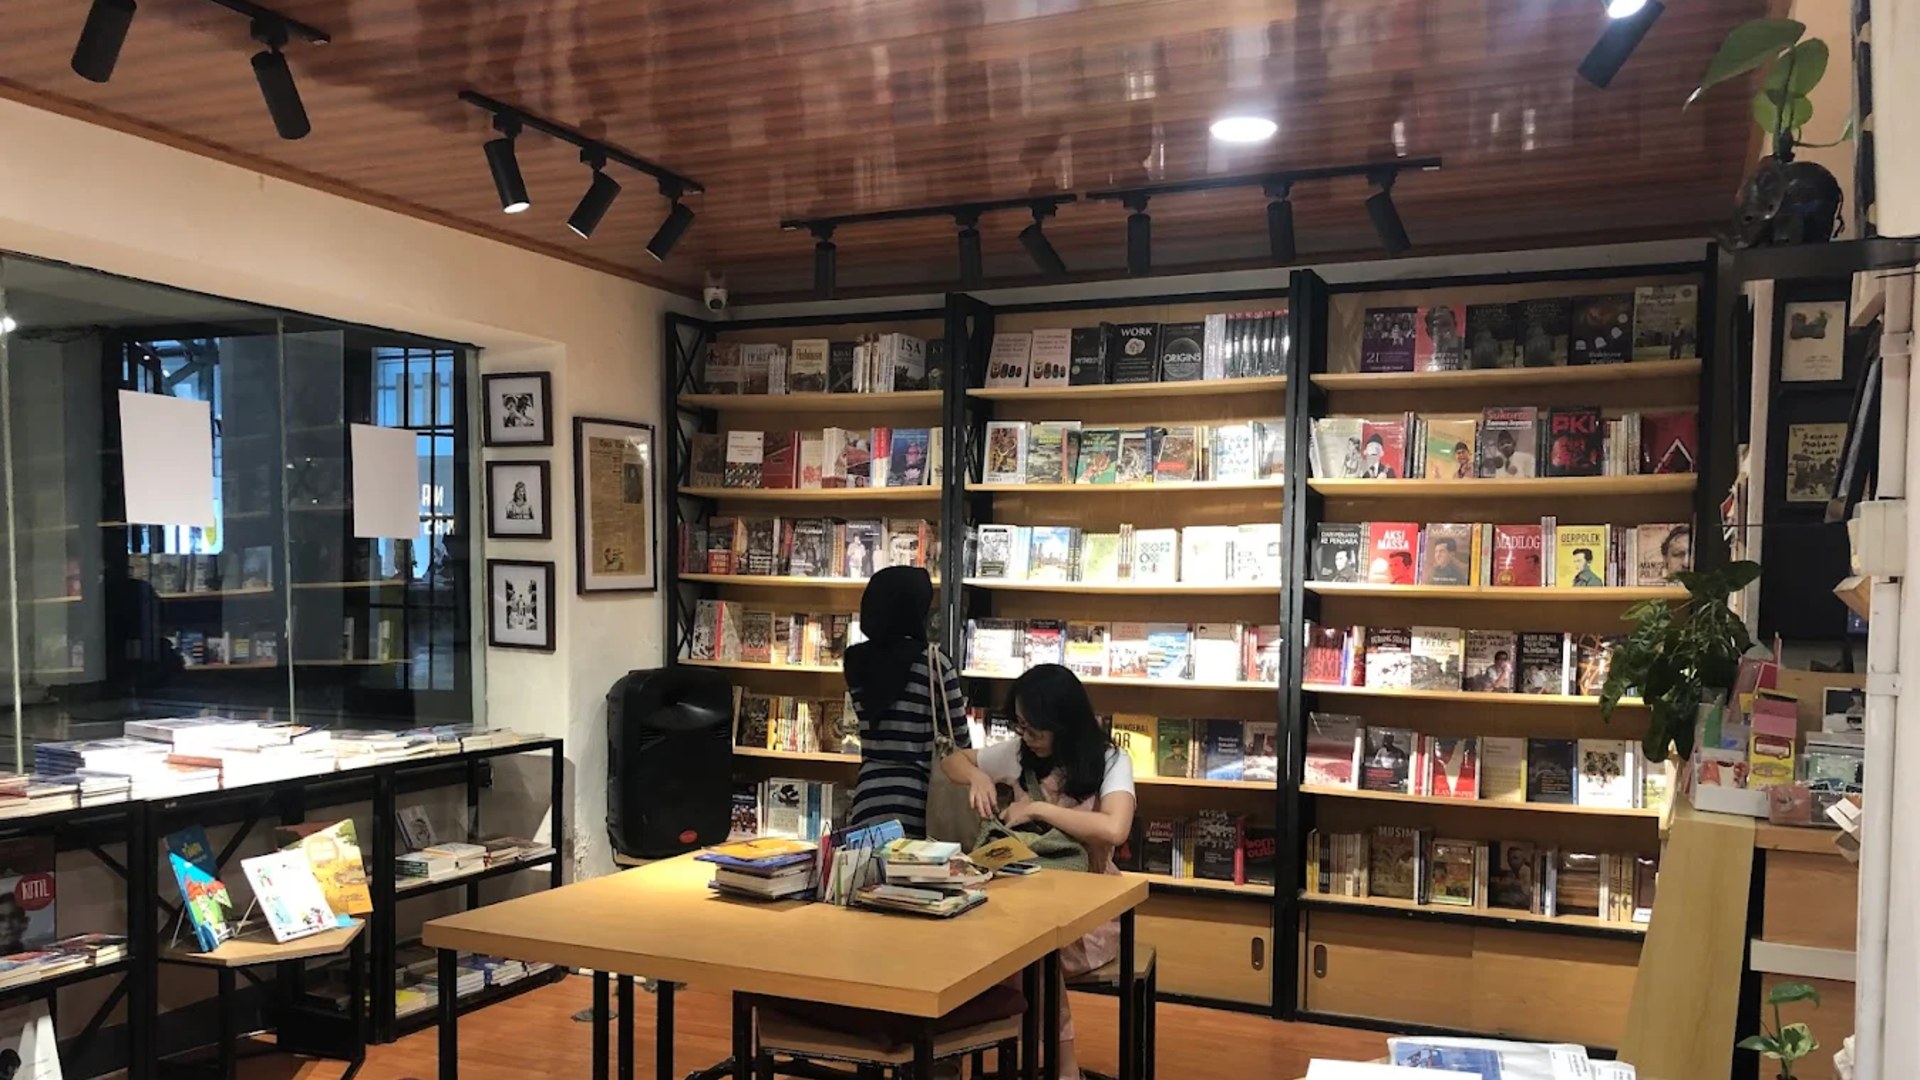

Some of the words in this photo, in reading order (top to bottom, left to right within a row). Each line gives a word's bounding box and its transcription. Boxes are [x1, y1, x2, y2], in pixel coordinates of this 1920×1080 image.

[1121, 327, 1153, 337] WORK
[901, 338, 921, 355] ISA
[1163, 352, 1201, 363] ORIGINS
[1552, 414, 1596, 434] PKI
[1384, 530, 1405, 540] AKSI
[1377, 540, 1410, 550] MASSA
